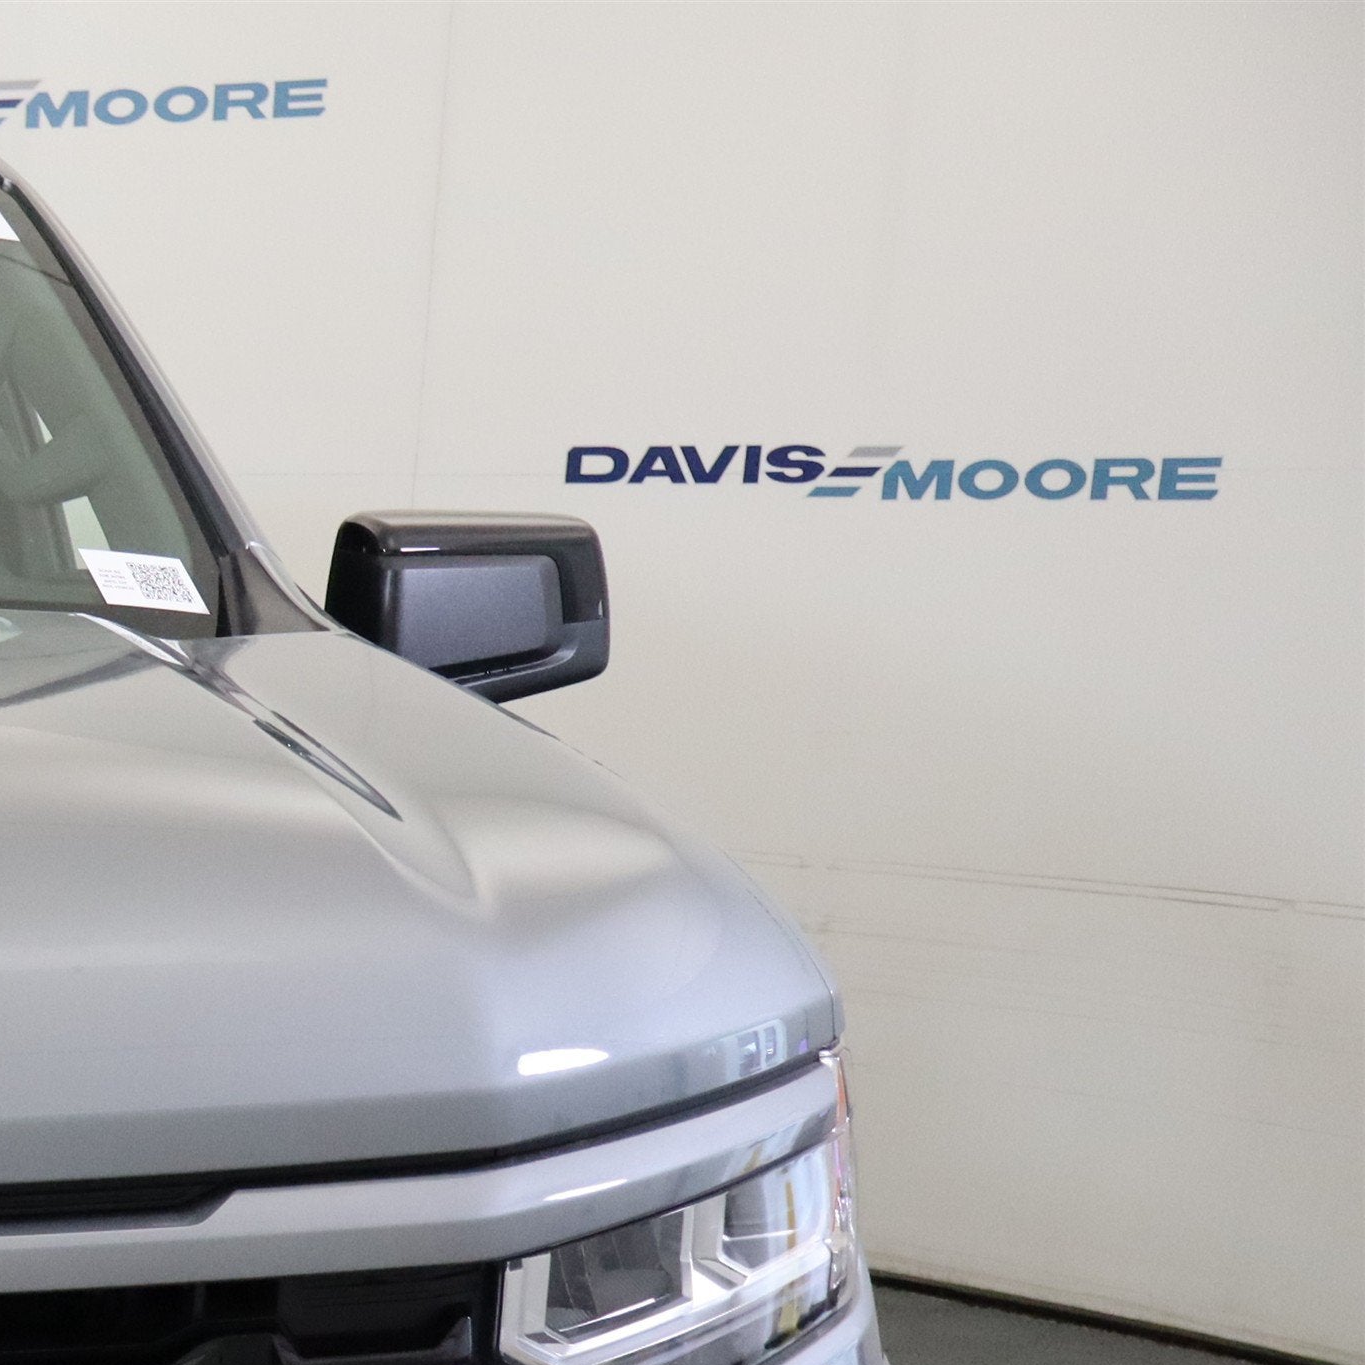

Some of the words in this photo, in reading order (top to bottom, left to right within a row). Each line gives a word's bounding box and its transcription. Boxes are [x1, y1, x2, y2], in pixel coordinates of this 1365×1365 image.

[24, 79, 328, 128] MOORE
[565, 445, 826, 485] DAVIS
[880, 457, 1223, 501] MOORE
